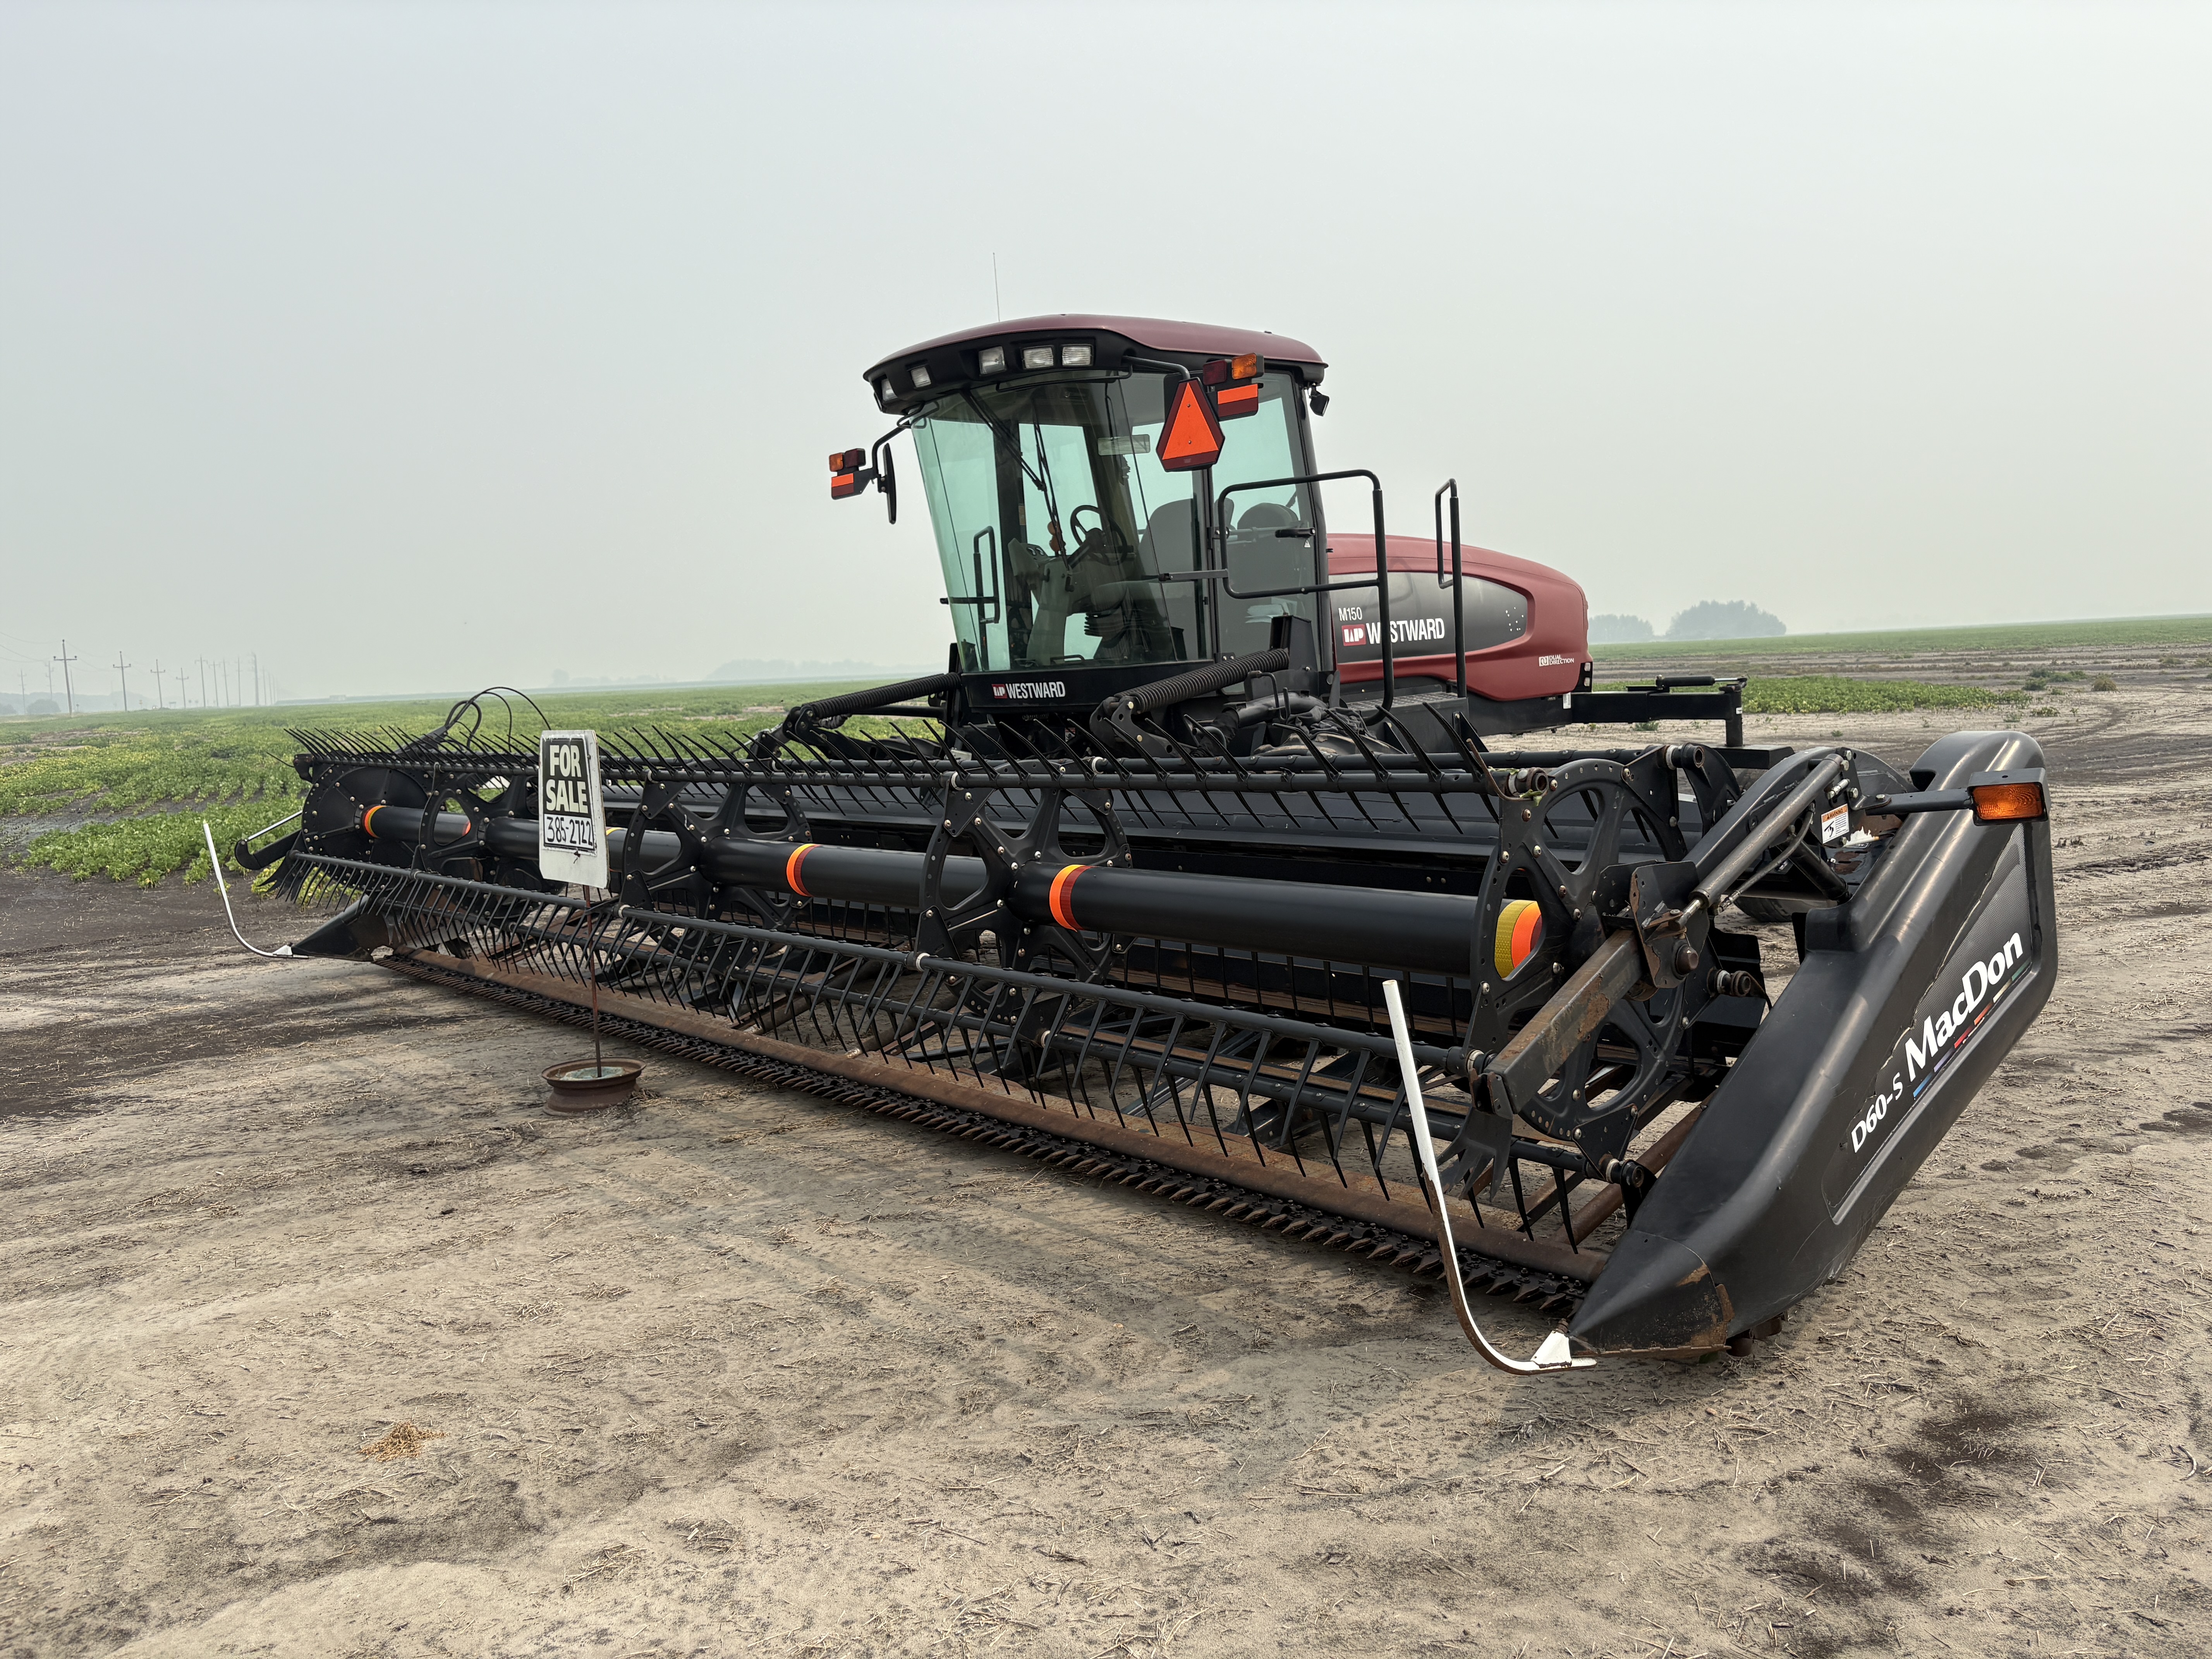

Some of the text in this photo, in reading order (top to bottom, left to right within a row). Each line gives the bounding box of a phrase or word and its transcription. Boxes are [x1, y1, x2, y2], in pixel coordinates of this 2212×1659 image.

[1338, 607, 1362, 621] M150
[1366, 618, 1445, 644] WSTWARD
[1006, 682, 1065, 699] WESTWARD
[550, 744, 582, 777] FOR
[546, 779, 588, 814] SALE
[546, 816, 593, 846] 385-2722
[1905, 932, 2023, 1082] MacDon
[1851, 1072, 1903, 1153] D60-S
